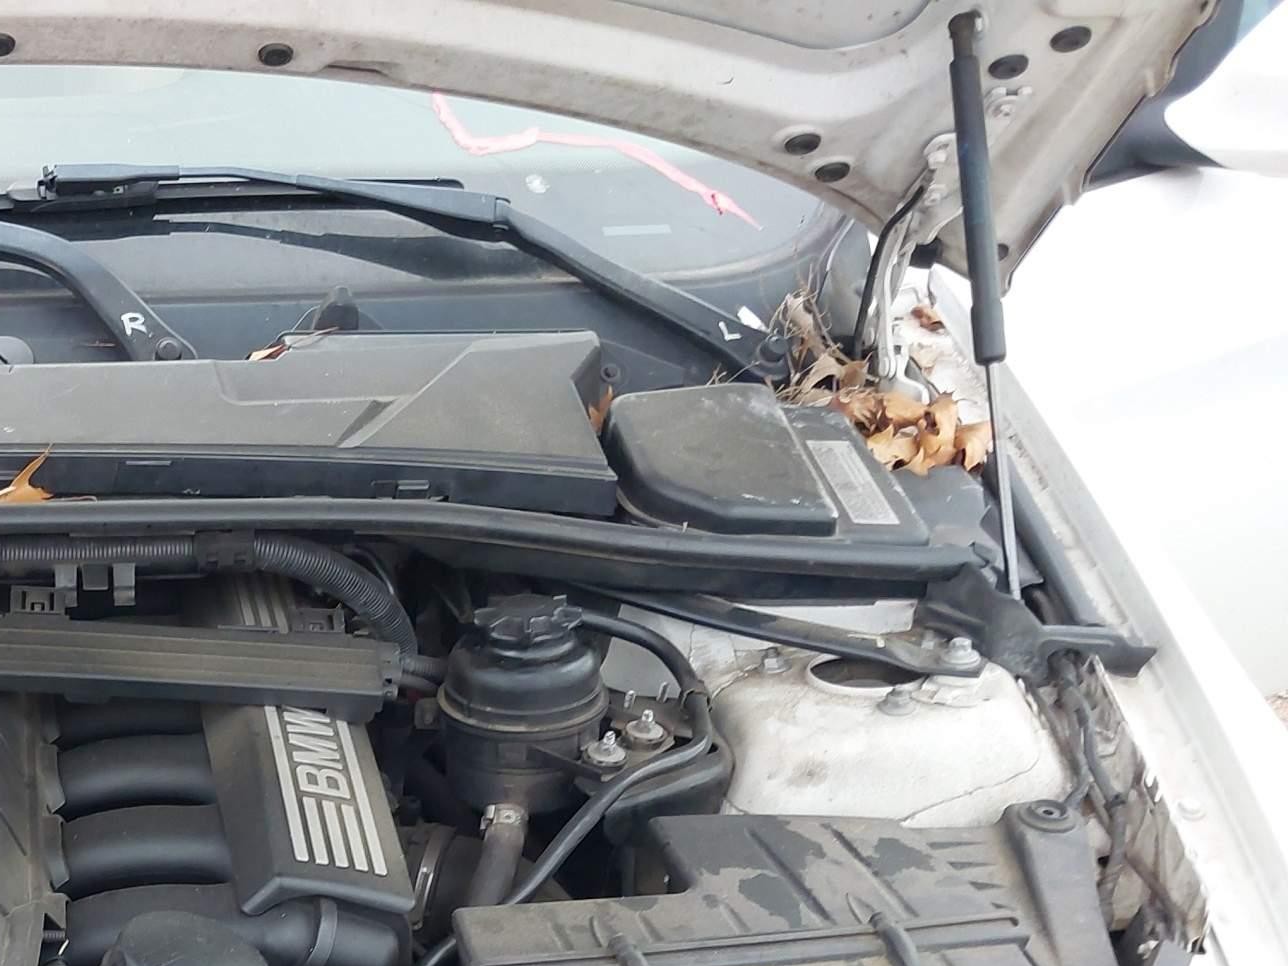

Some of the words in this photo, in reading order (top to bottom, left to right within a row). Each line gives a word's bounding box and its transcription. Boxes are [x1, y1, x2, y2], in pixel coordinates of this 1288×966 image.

[120, 312, 148, 337] R
[718, 321, 743, 342] L
[282, 705, 351, 800] BMW
